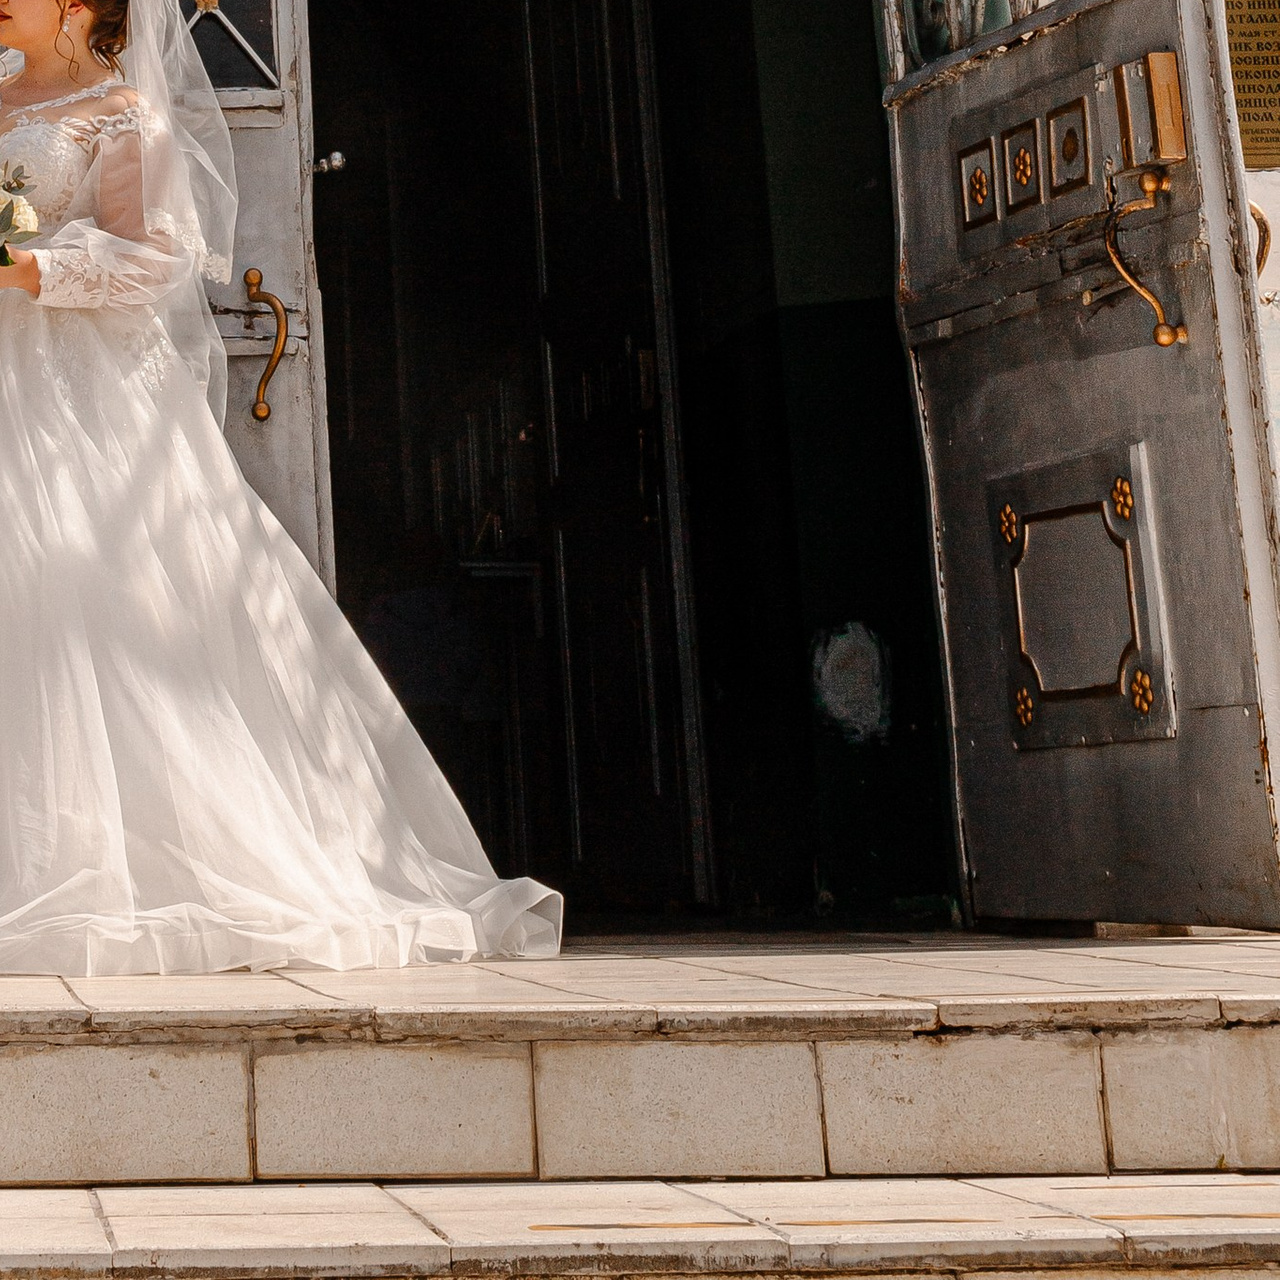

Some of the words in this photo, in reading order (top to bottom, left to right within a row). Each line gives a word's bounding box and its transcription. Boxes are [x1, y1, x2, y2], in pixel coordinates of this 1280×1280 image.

[1248, 0, 1280, 10] ИНИ
[1228, 14, 1280, 24] АТАМА
[1232, 70, 1280, 80] СКОПО
[1234, 84, 1280, 95] ИНОДА
[1236, 98, 1280, 109] ВЯЩЕ
